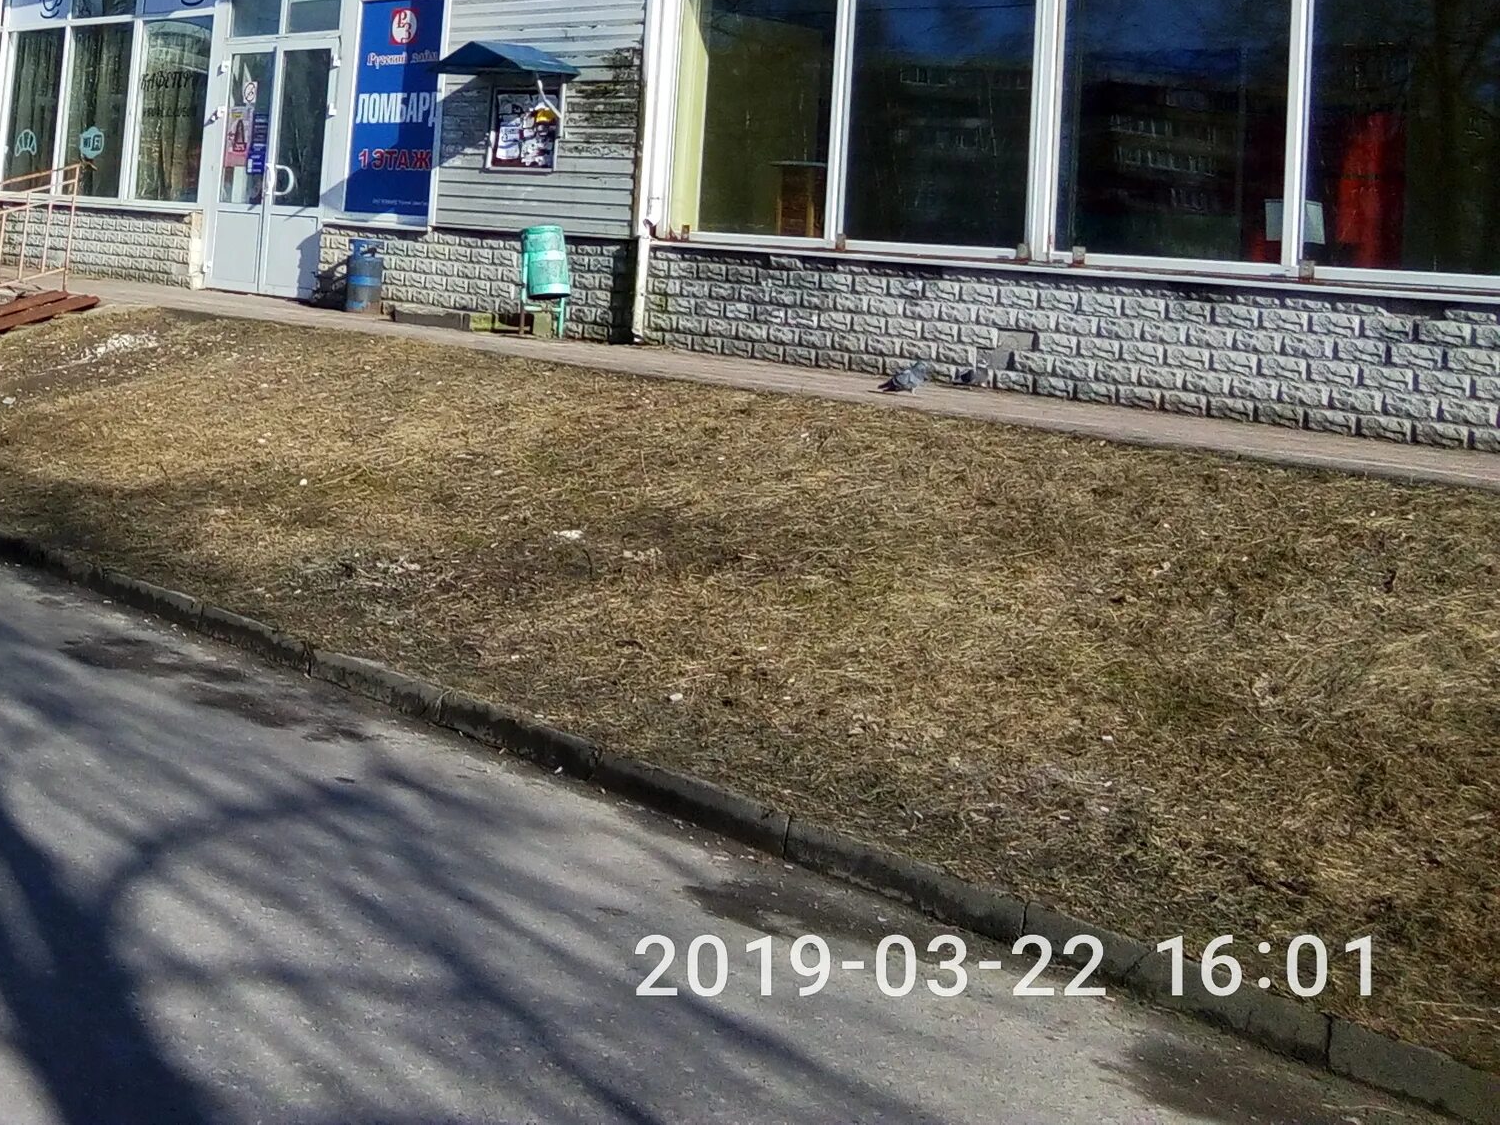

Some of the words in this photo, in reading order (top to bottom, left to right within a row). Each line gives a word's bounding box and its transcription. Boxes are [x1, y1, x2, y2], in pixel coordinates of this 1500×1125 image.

[355, 92, 442, 127] ЛОМБАРД
[358, 148, 369, 170] 1
[372, 148, 432, 171] ЭТАЖ
